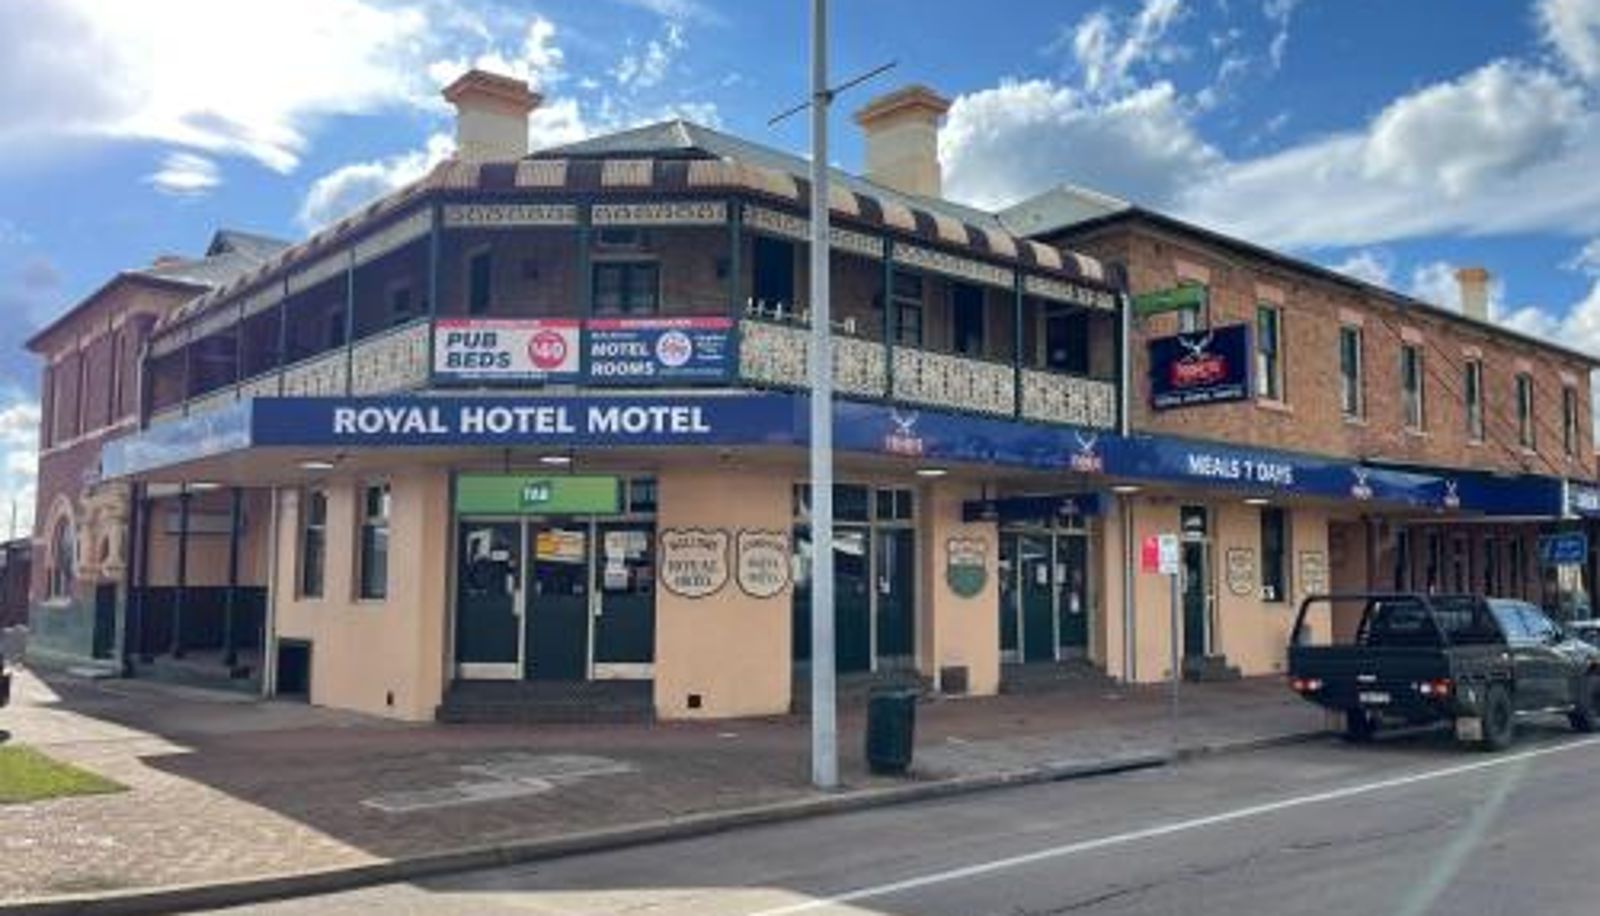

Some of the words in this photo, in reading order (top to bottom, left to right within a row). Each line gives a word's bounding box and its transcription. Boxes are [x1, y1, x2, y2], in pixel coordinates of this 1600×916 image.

[446, 332, 498, 349] PUB
[591, 342, 650, 357] MOTEL
[446, 351, 512, 369] BEDS
[591, 361, 654, 377] ROOMS
[333, 407, 448, 435] ROYAL
[459, 407, 575, 434] HOTEL
[588, 406, 710, 433] MOTEL
[1188, 454, 1239, 478] MEALS
[1243, 461, 1252, 480] 7
[1256, 462, 1293, 484] DAYS
